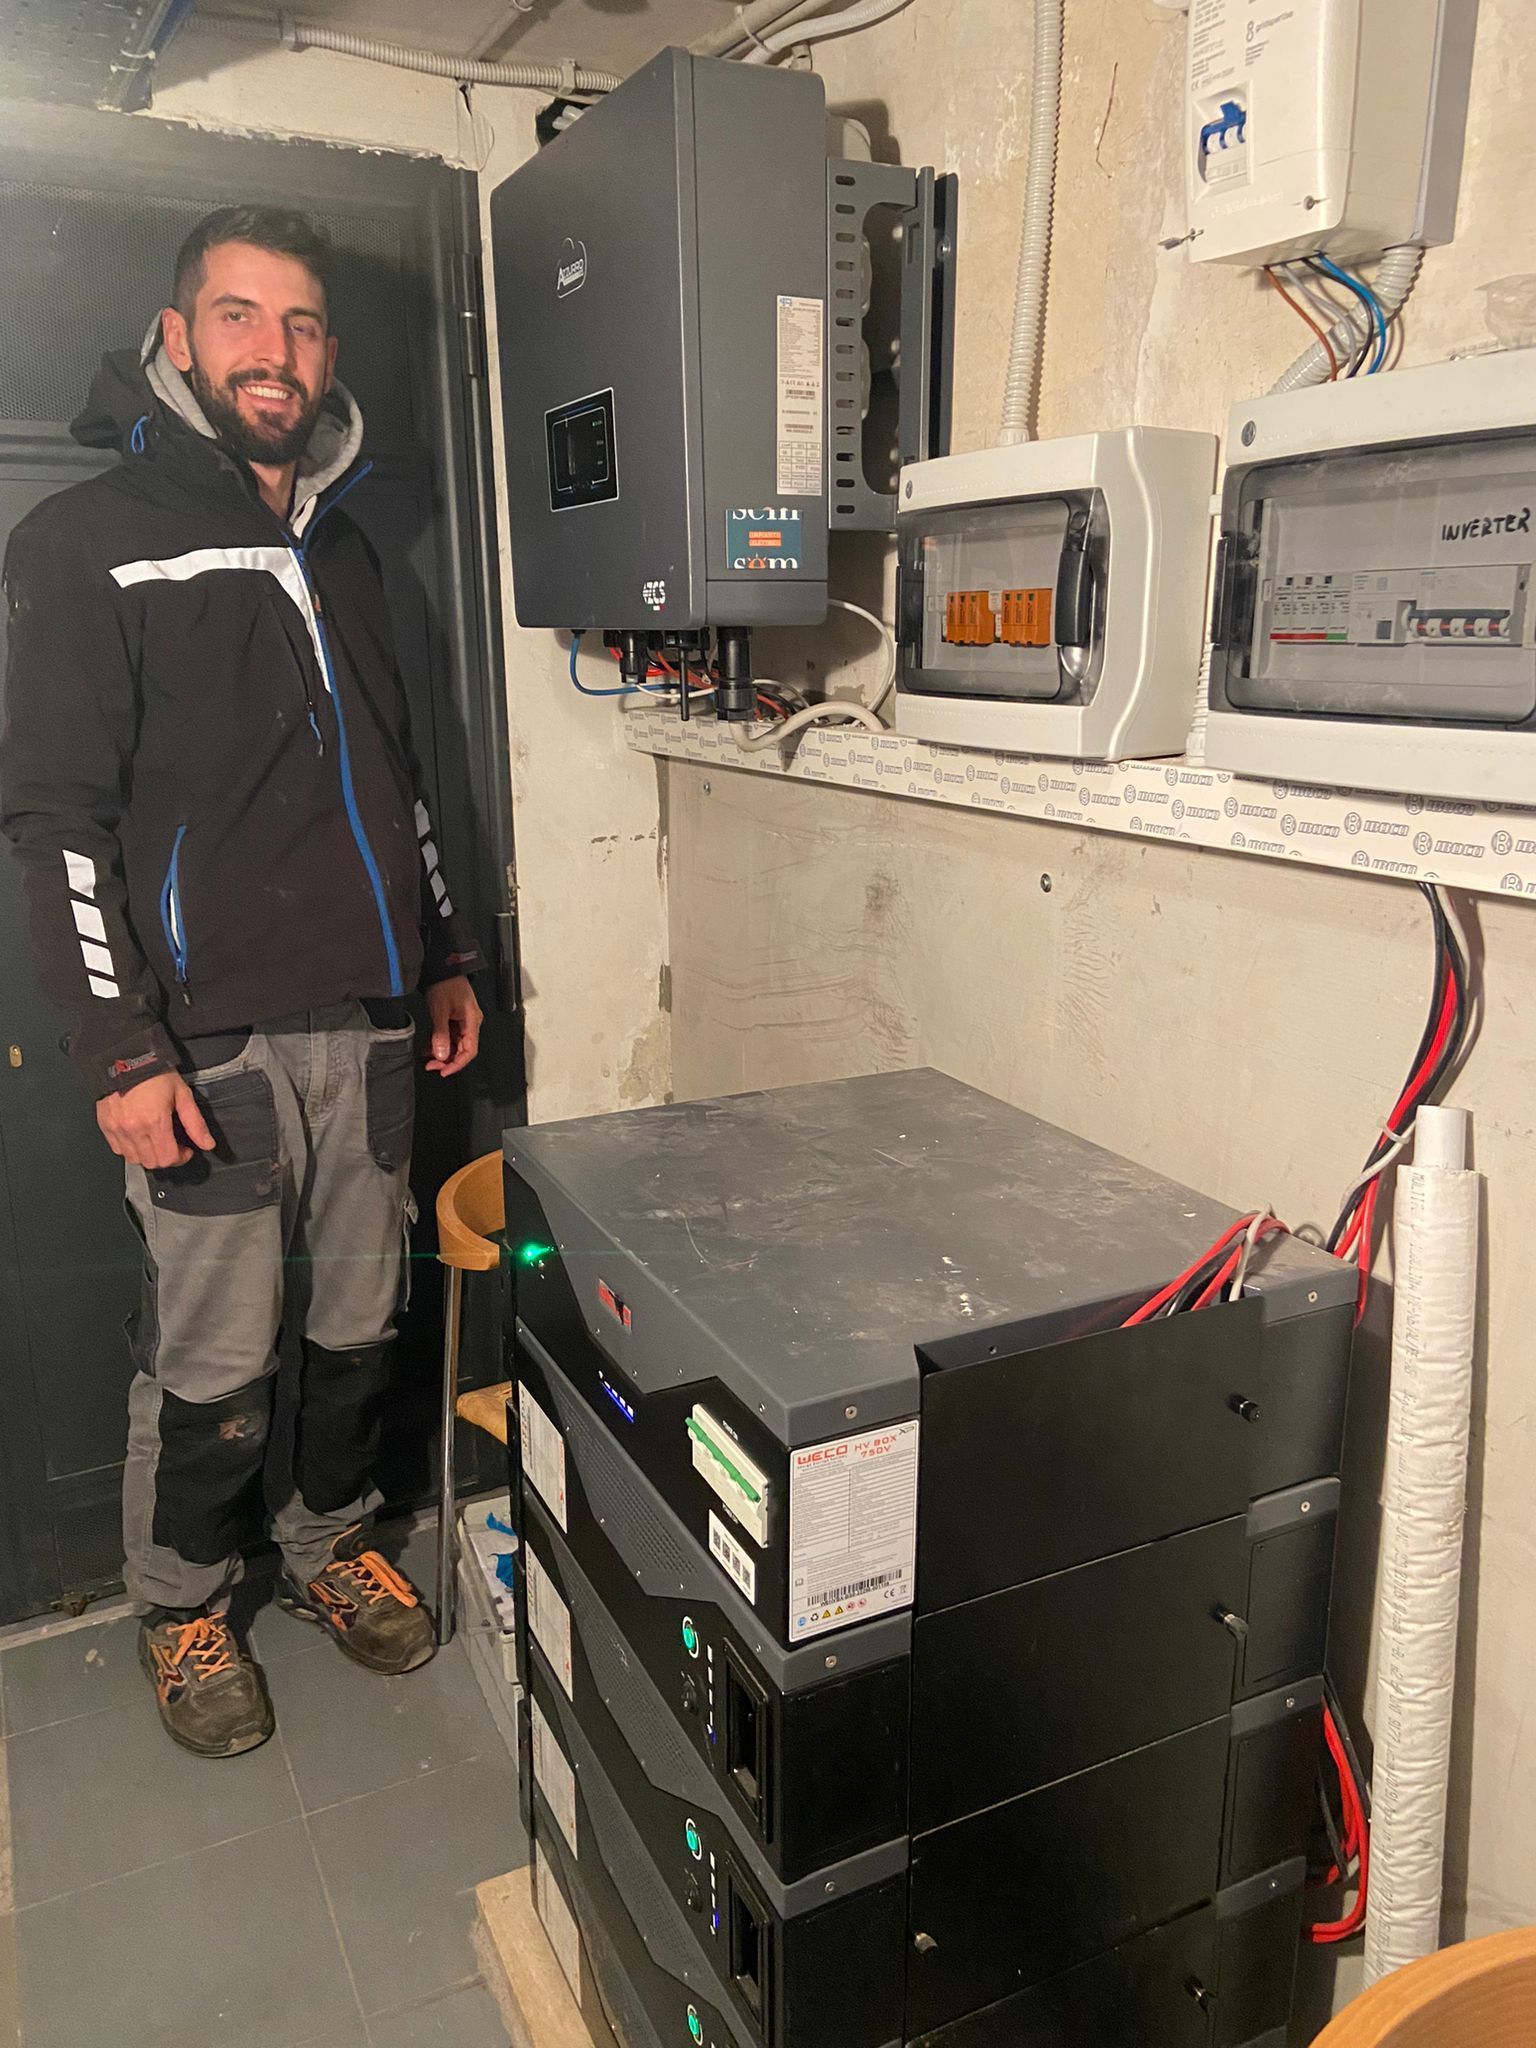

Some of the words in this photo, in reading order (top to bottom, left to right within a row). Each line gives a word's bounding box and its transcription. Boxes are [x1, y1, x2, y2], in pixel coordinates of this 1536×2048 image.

[1441, 507, 1531, 541] INVERTER
[1434, 840, 1484, 858] IBOCO
[797, 1444, 848, 1465] WECO
[854, 1442, 870, 1452] HV
[874, 1434, 897, 1447] BOX
[860, 1445, 891, 1458] 750V
